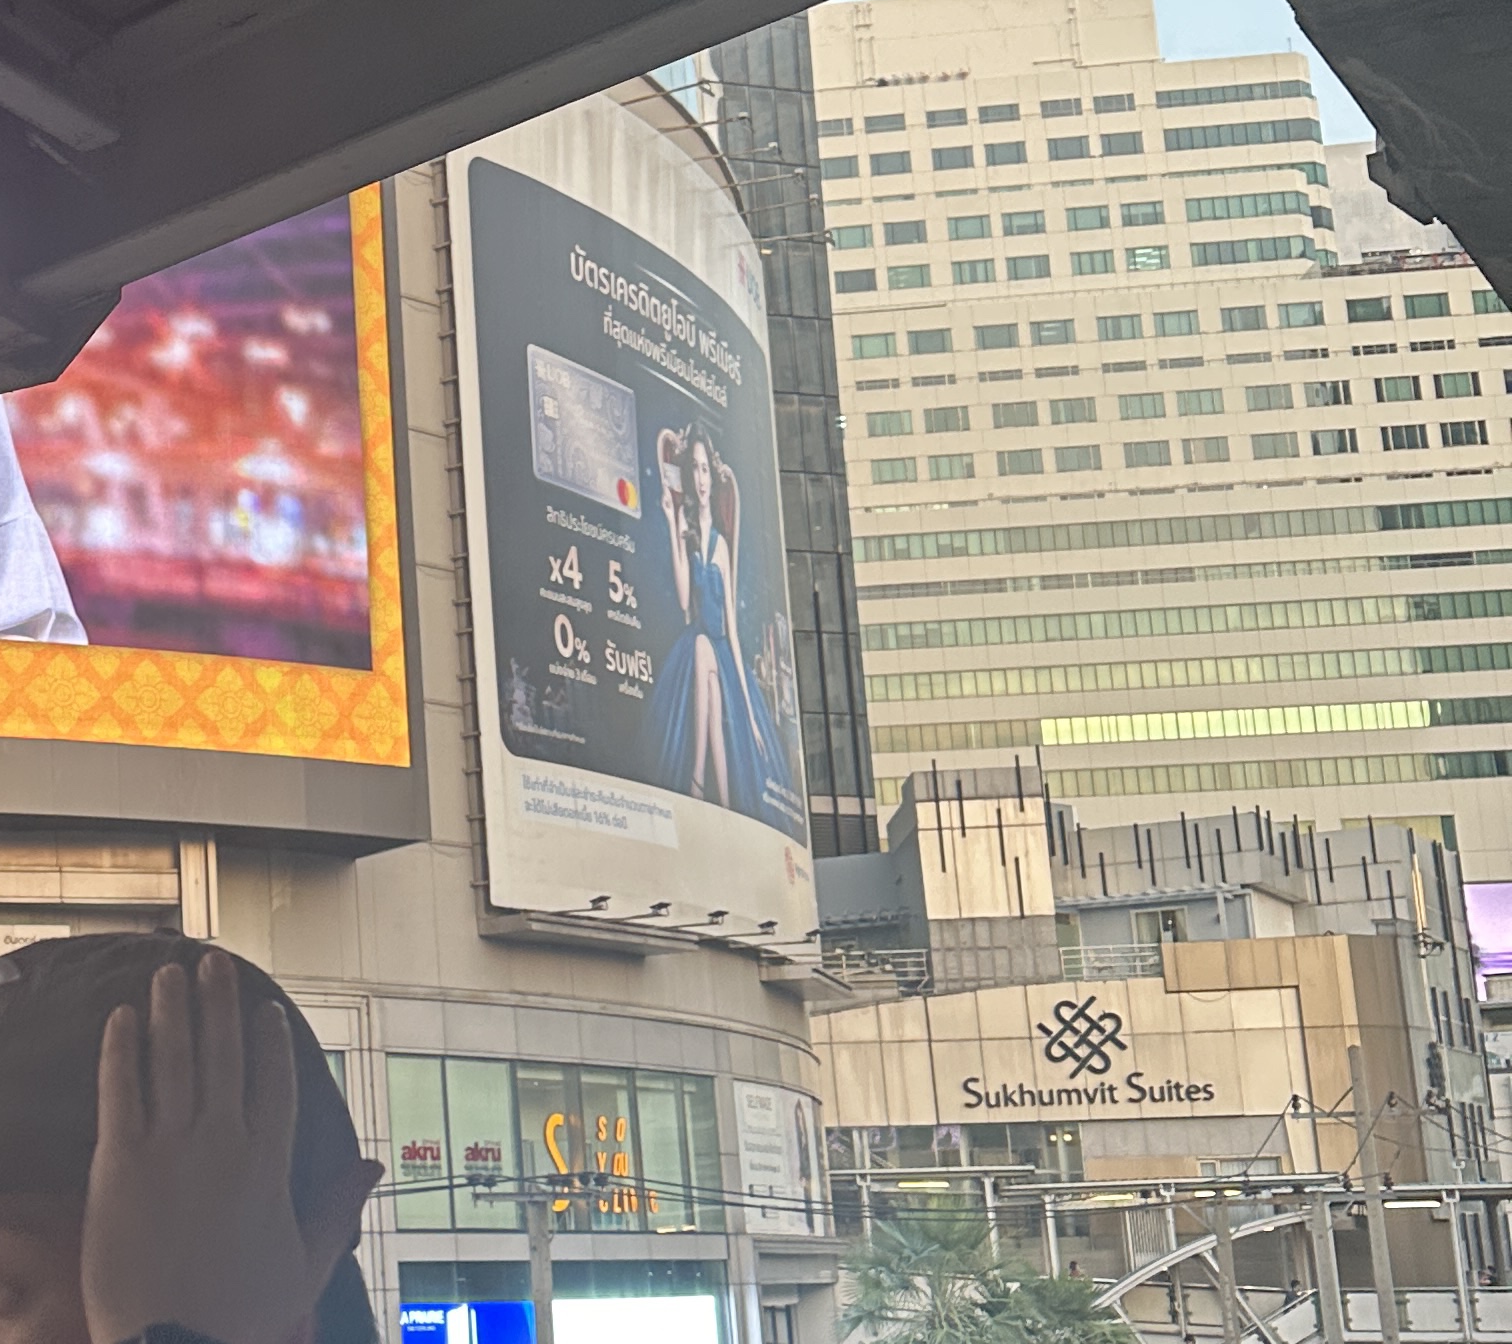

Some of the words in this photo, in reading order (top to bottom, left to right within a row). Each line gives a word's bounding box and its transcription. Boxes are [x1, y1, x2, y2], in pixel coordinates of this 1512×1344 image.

[548, 545, 584, 590] x4
[608, 560, 638, 609] 5%
[554, 613, 591, 664] 0%
[963, 1077, 1118, 1108] Sukhumvit
[1126, 1072, 1215, 1103] Suites
